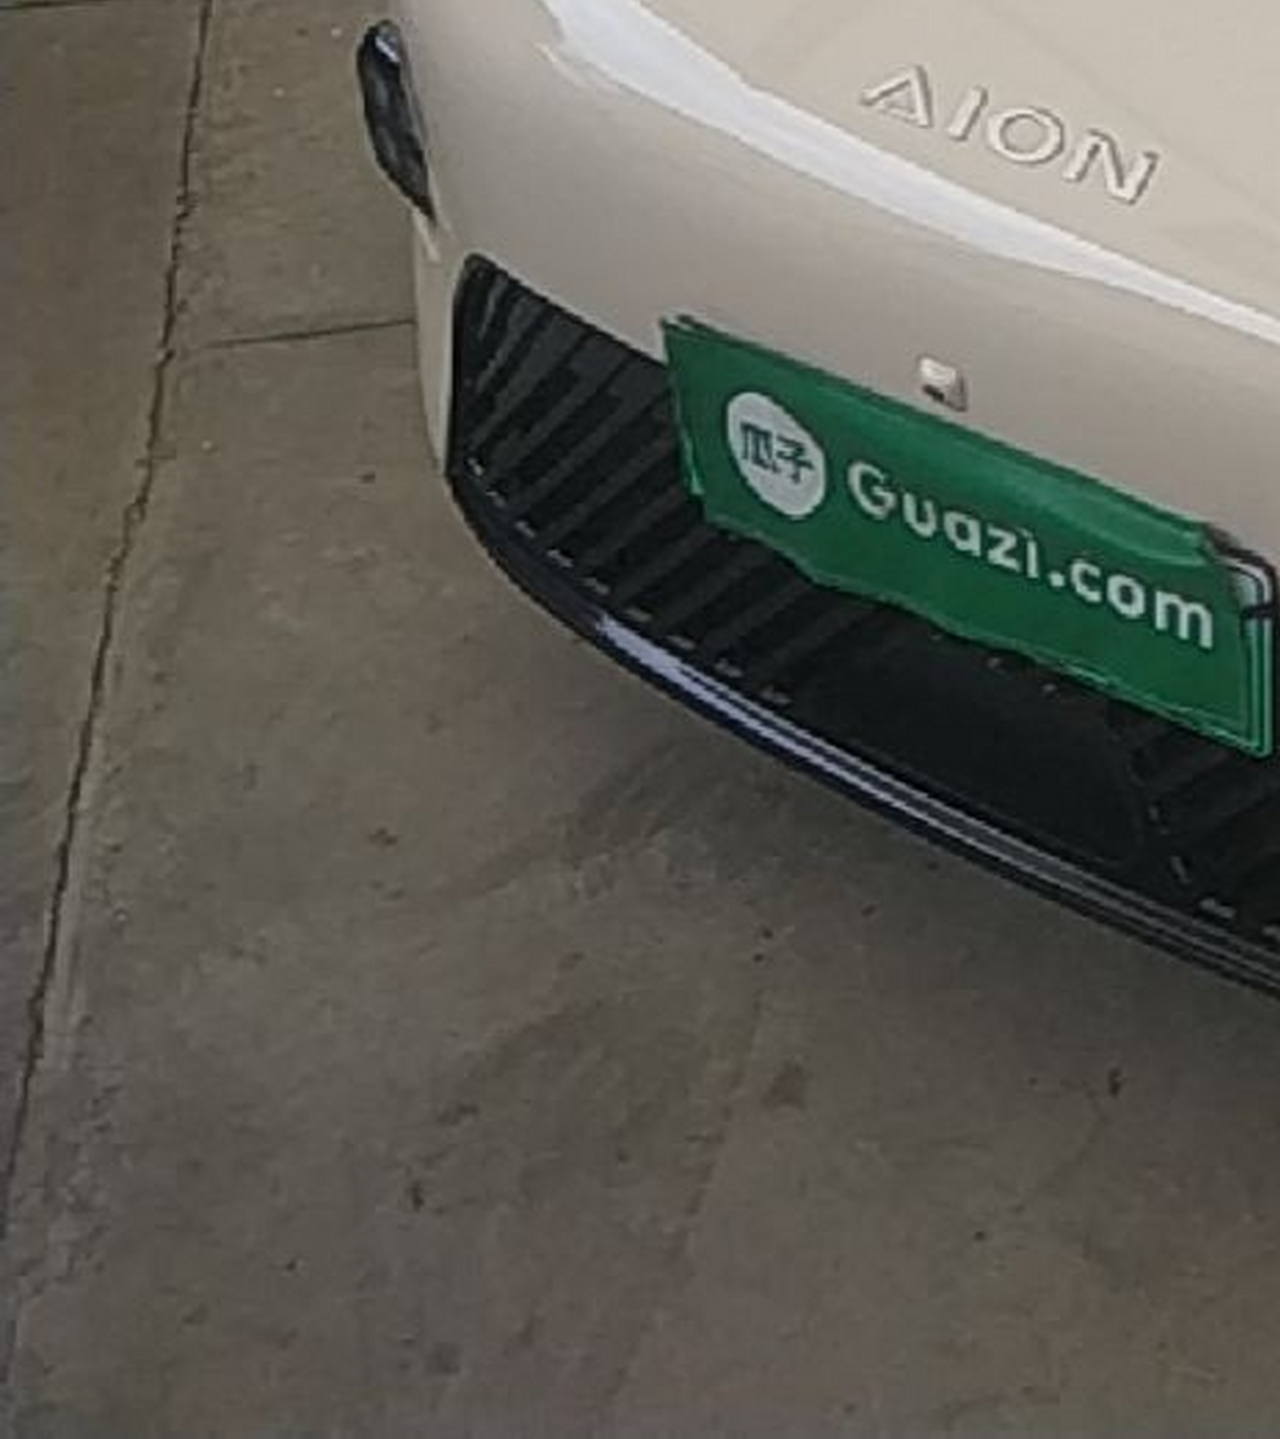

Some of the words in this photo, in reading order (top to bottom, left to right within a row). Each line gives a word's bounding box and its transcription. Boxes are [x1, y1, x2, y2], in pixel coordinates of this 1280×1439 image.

[859, 63, 1160, 206] AION
[739, 421, 815, 484] 瓜子
[846, 459, 1214, 651] Guazi.com
